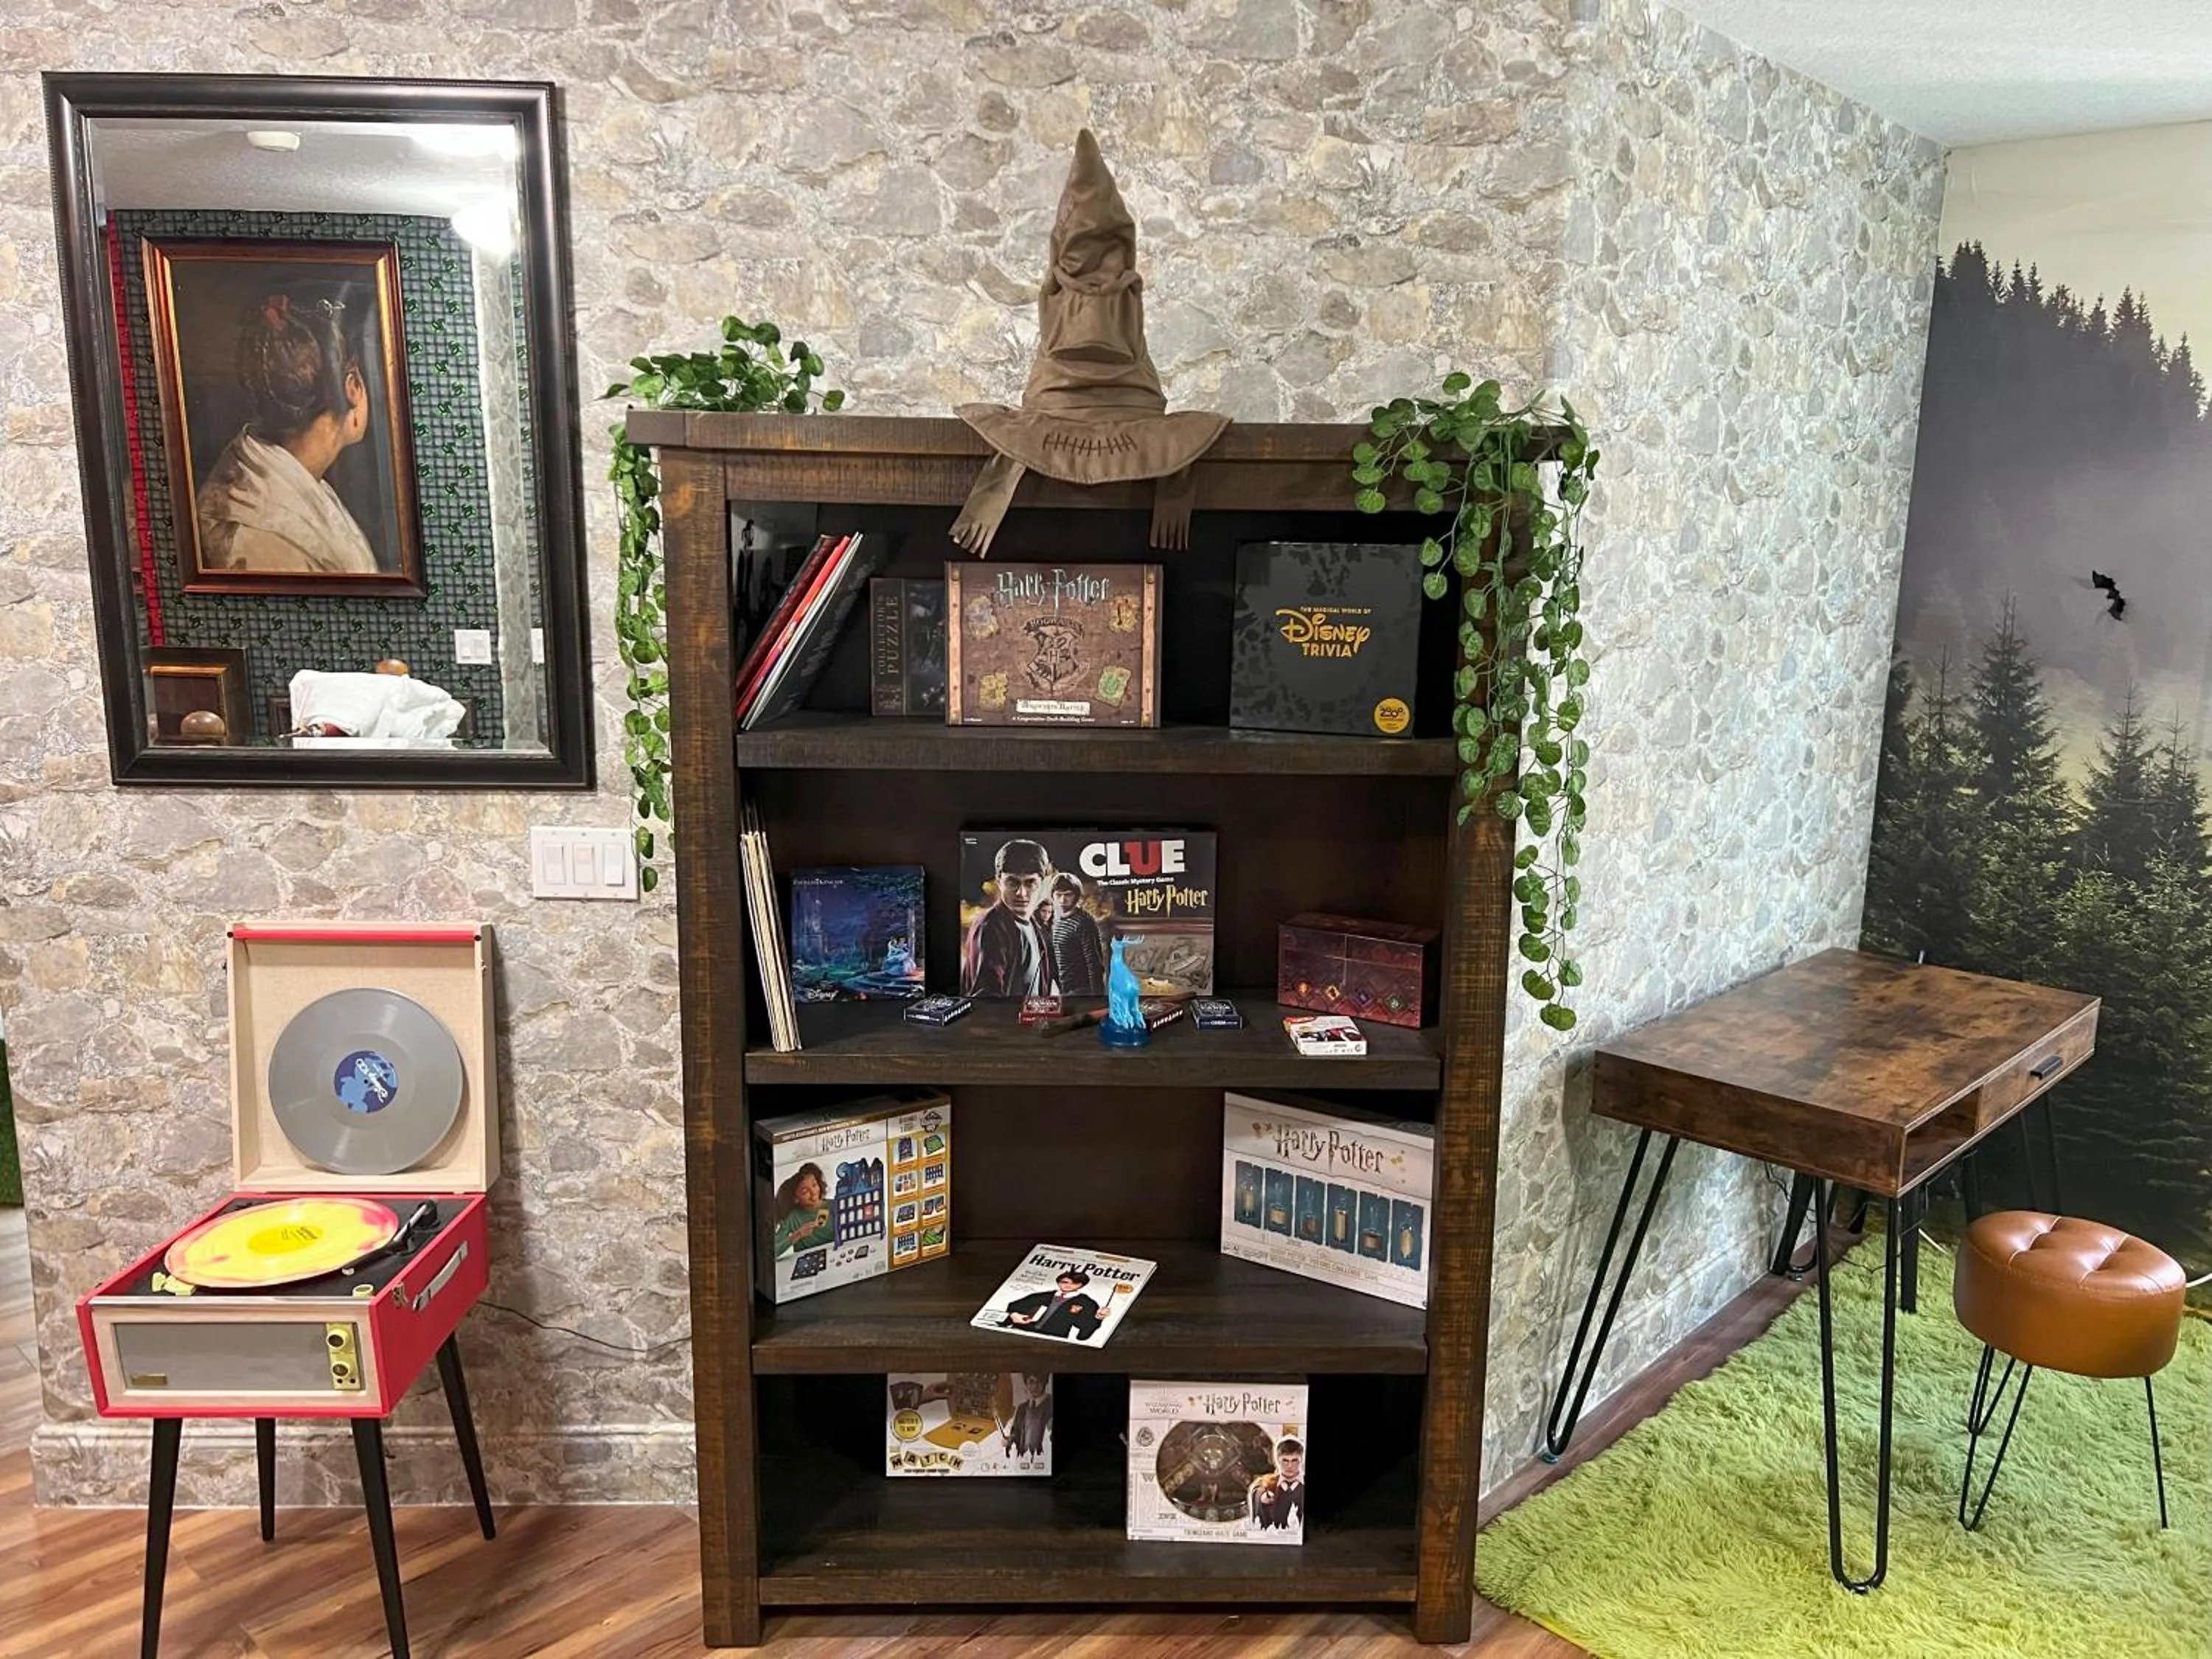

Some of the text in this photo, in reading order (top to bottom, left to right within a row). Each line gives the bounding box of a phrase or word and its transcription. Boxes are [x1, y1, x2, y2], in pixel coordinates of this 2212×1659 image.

[996, 568, 1110, 616] Harry Potter
[886, 596, 899, 673] PUZZLE
[1301, 643, 1352, 658] TRIVIA
[1079, 840, 1186, 877] CLUE
[1125, 884, 1209, 919] Harry Potter
[1274, 1123, 1384, 1174] Harry Potter
[1029, 1254, 1083, 1273] Harry
[1082, 1263, 1141, 1281] Potter
[1203, 1391, 1281, 1419] Harry Potter
[891, 1453, 961, 1470] MATCH
